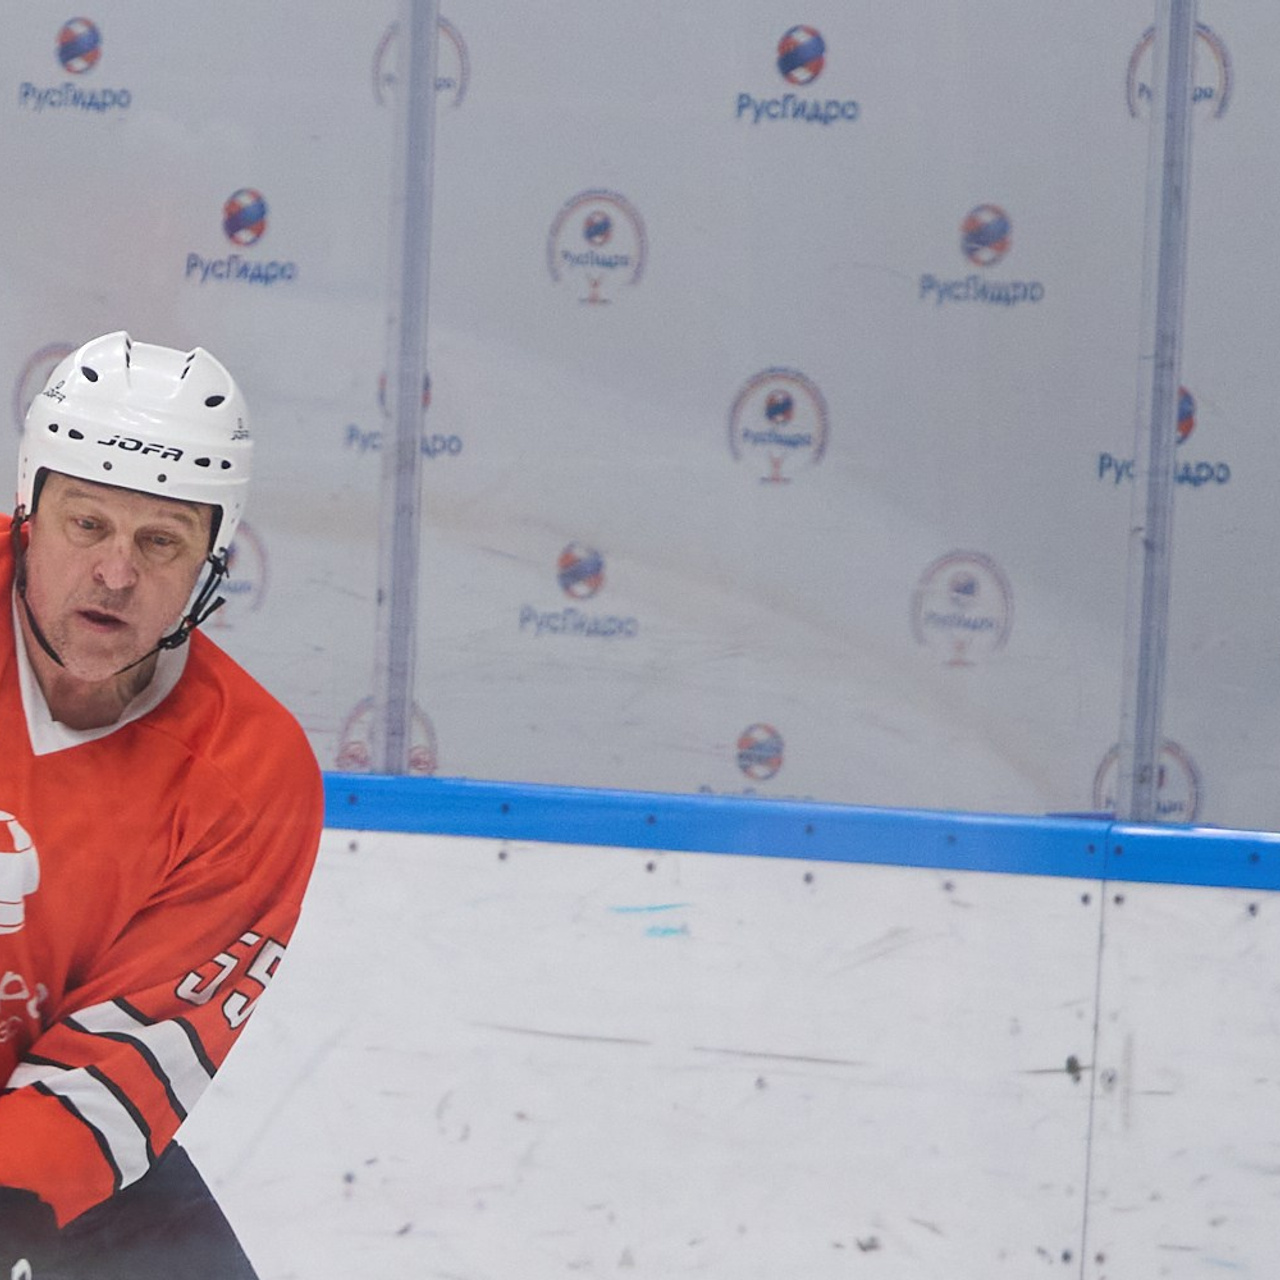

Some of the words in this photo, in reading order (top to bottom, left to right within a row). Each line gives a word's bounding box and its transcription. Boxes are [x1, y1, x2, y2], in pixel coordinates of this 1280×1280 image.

[736, 93, 860, 124] РусГидро
[185, 253, 297, 284] РусГидро
[920, 274, 1045, 305] РусГидро
[97, 435, 183, 461] JOFA
